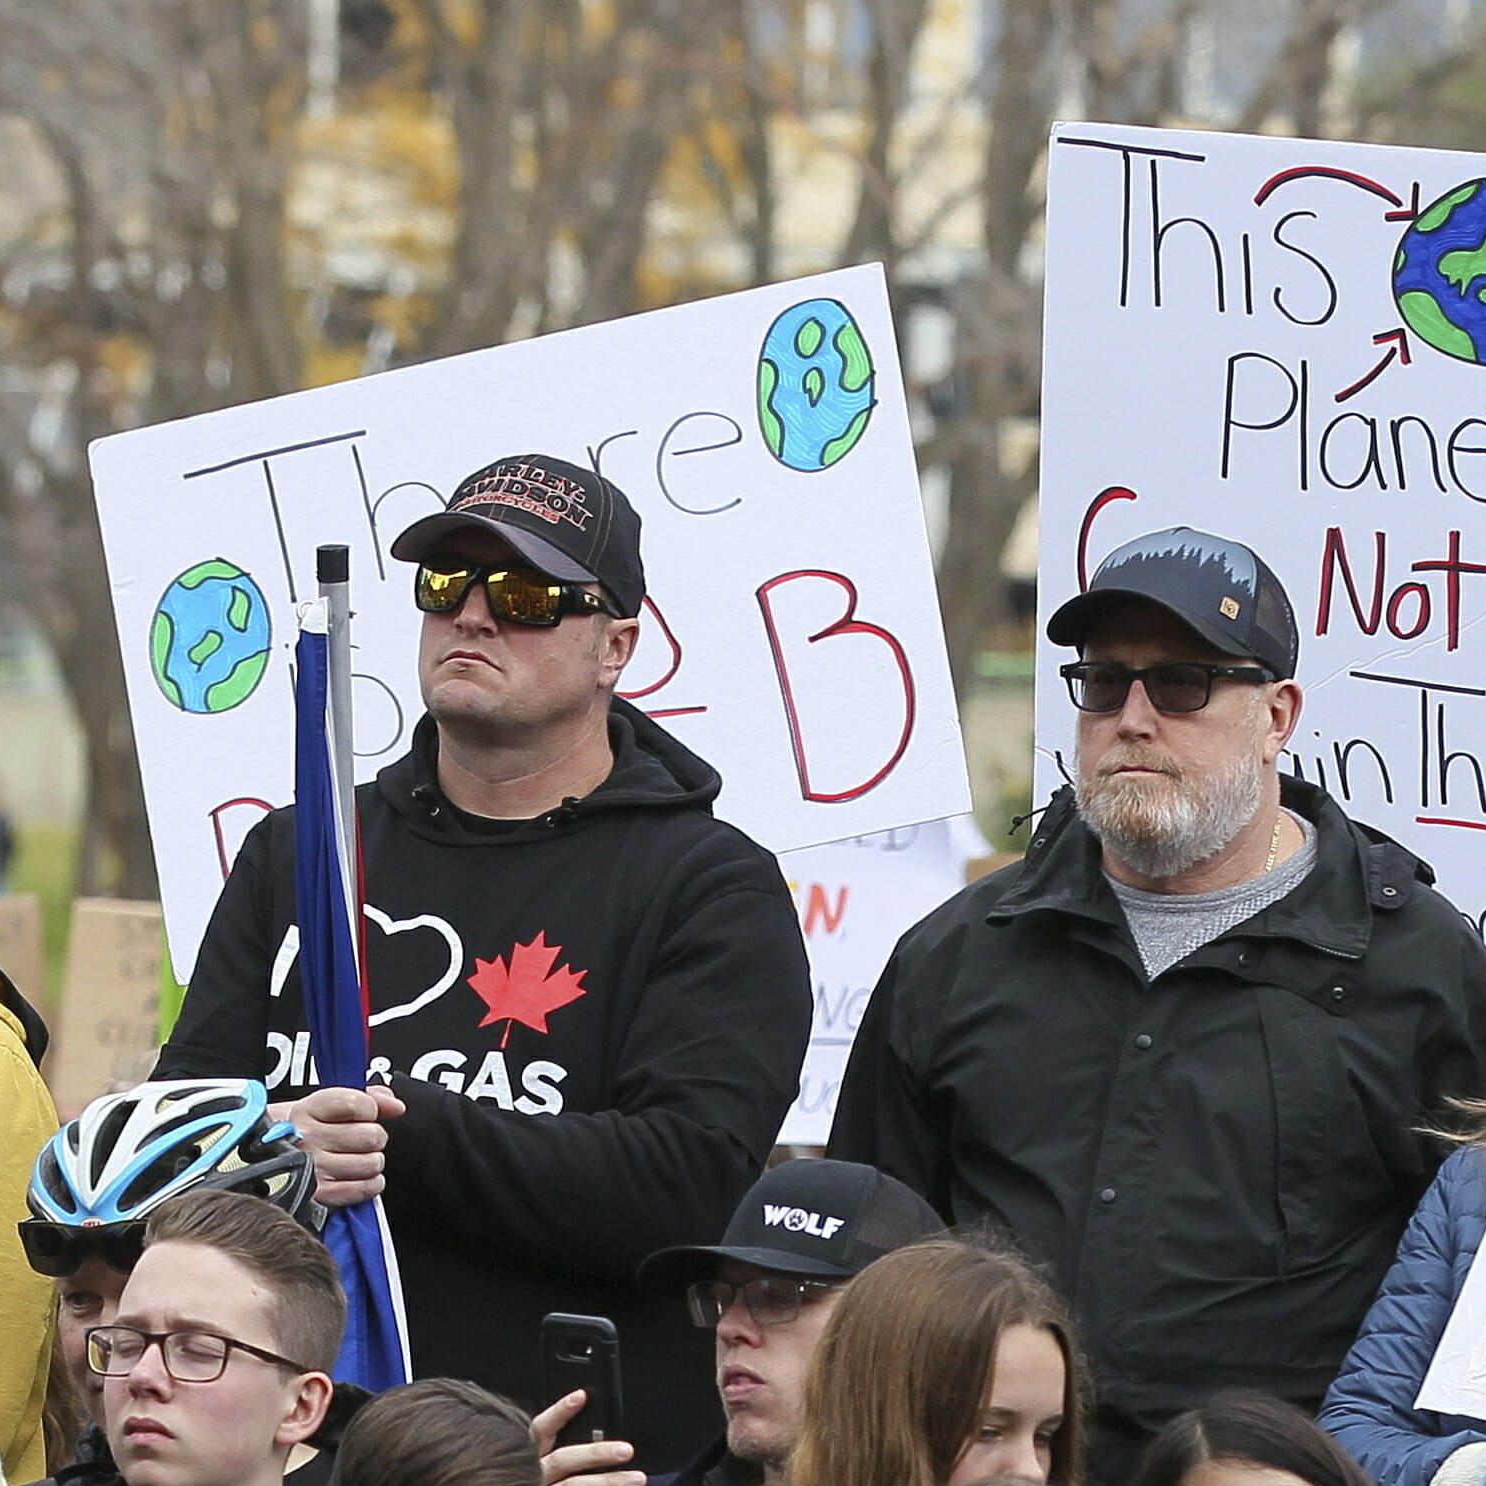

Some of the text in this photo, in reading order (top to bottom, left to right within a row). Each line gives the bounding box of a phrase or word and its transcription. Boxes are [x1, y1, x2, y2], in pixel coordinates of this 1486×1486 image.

[1057, 136, 1338, 326] This
[182, 410, 745, 606] Thre
[755, 568, 917, 804] B
[409, 1048, 569, 1117] GAS
[763, 1204, 845, 1240] WOLF
